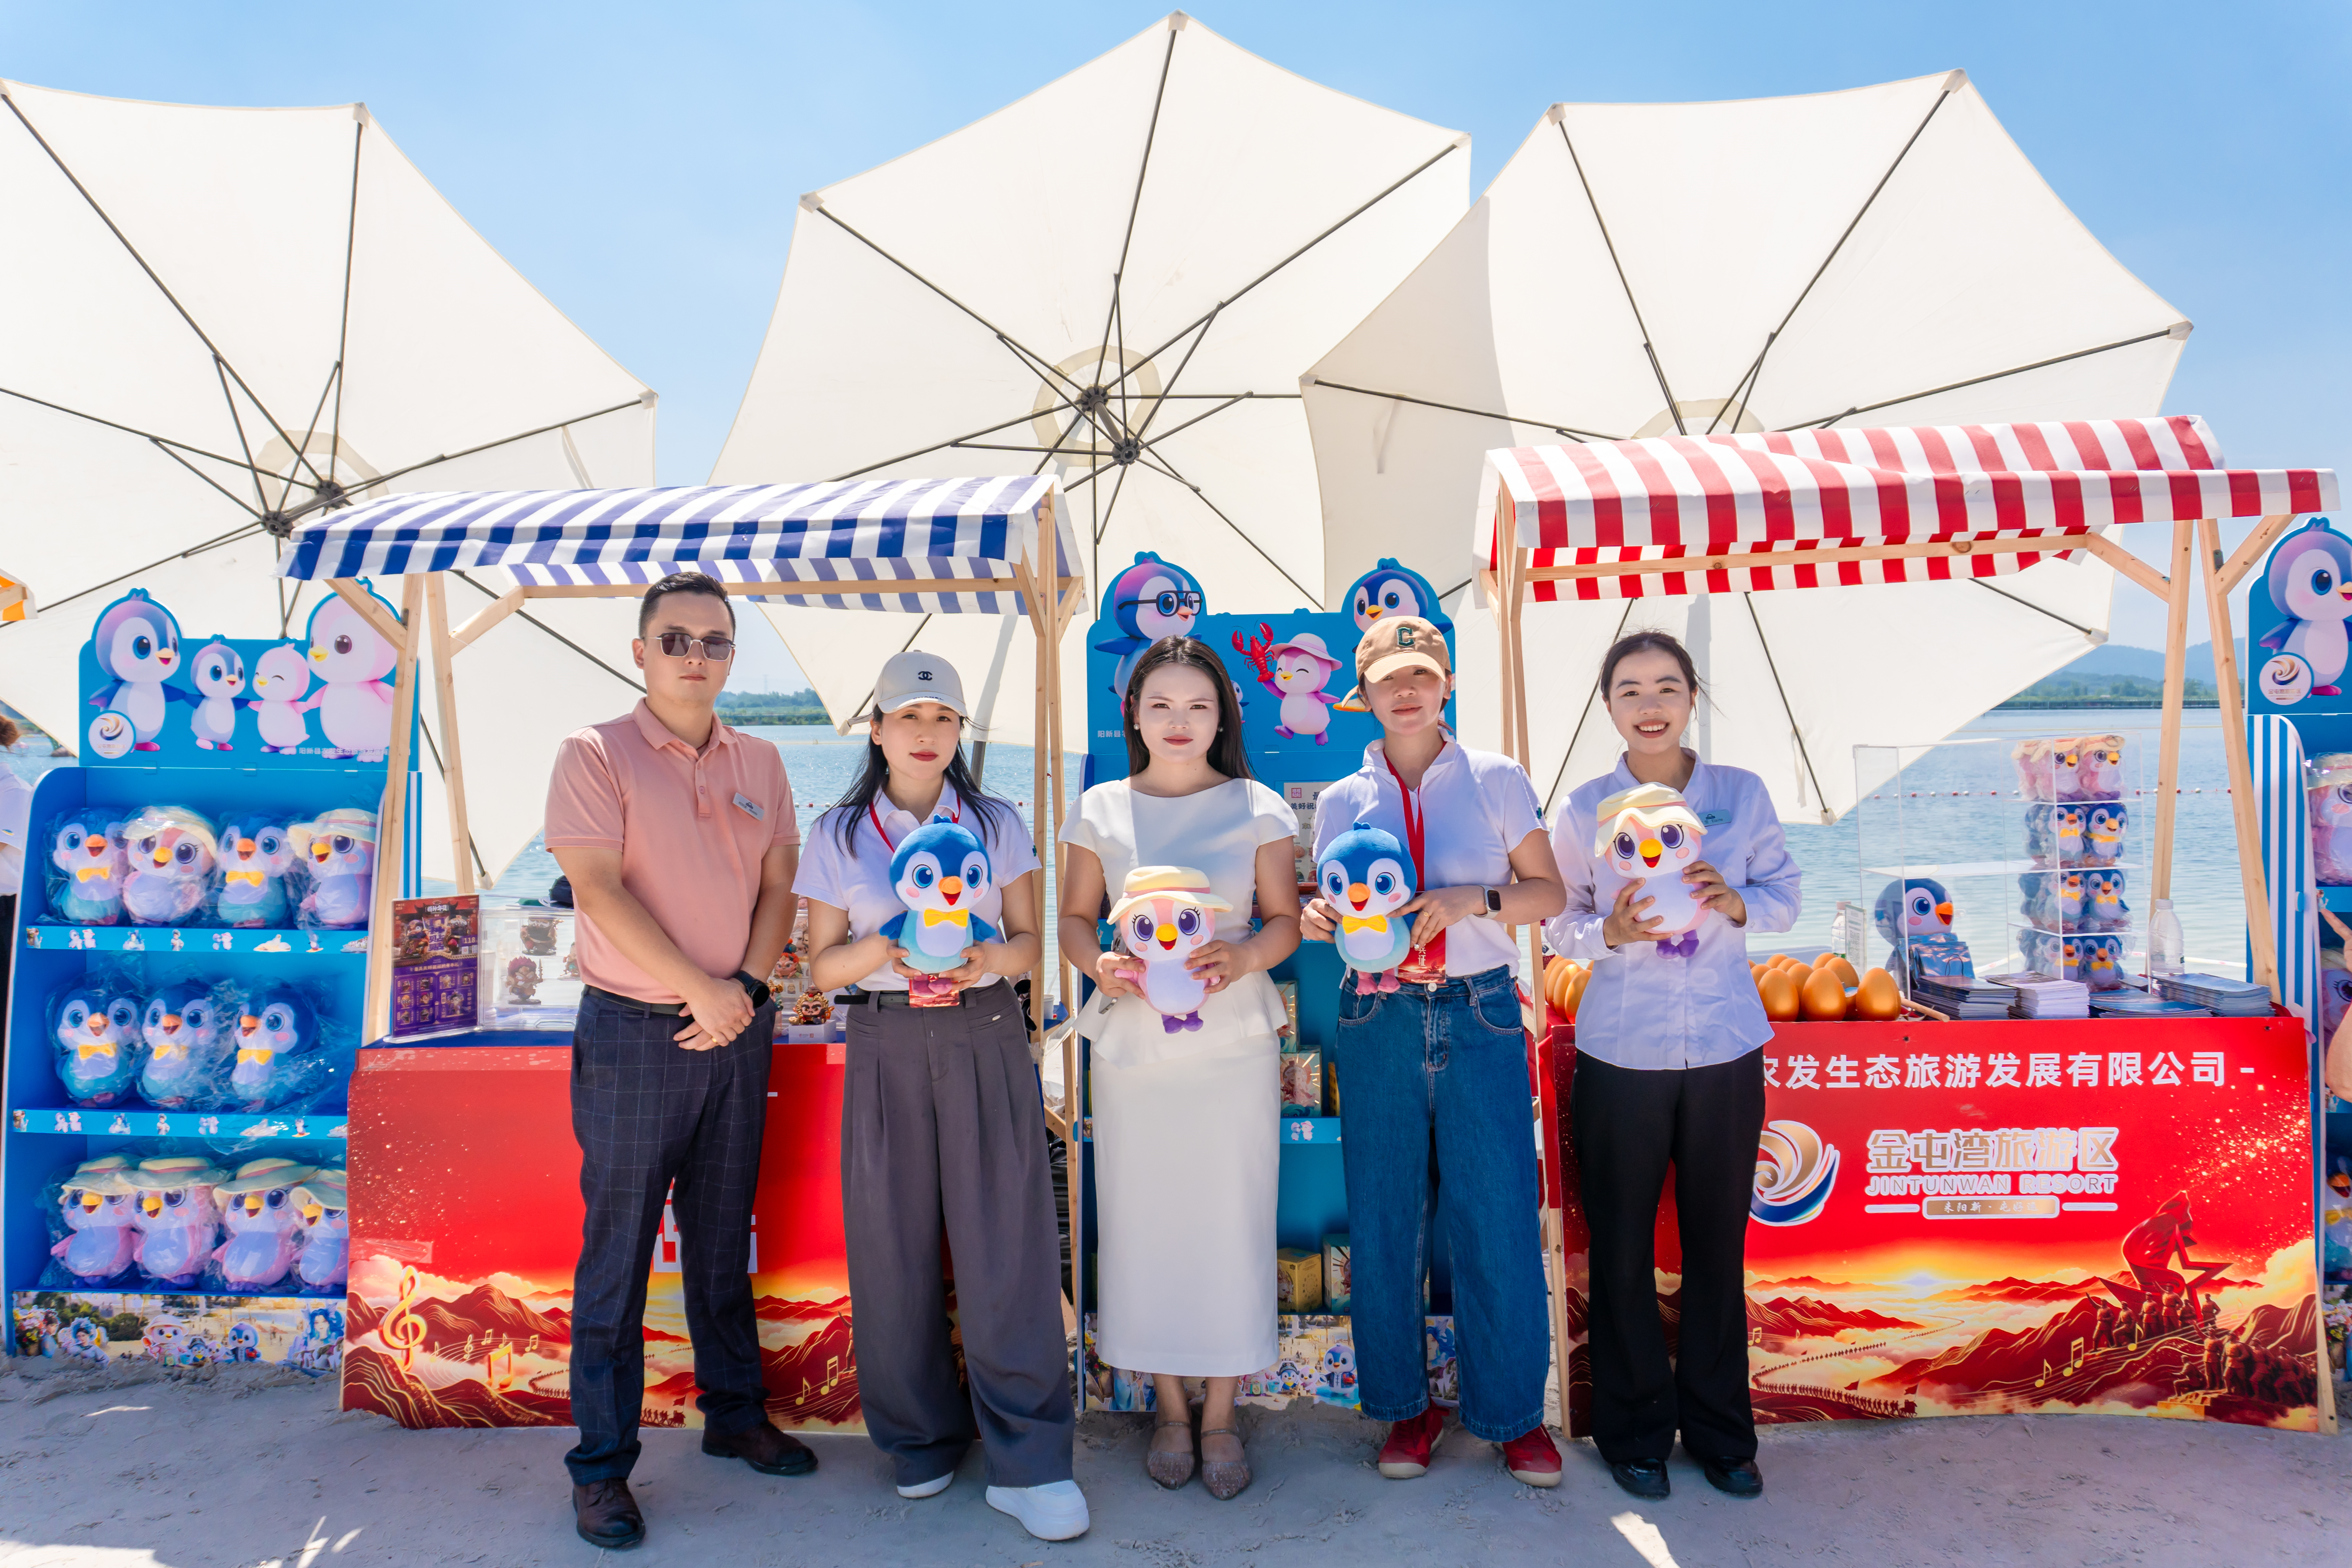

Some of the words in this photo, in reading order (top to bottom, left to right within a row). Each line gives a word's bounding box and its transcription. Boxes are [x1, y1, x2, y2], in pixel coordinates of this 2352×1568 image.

[1396, 627, 1415, 647] C
[299, 747, 410, 756] 阳新县农发生态旅游发展有
[1869, 1129, 2117, 1171] 金屯湾旅游区
[1867, 1175, 2010, 1194] JINTUNWAN
[2021, 1175, 2117, 1193] RESORT
